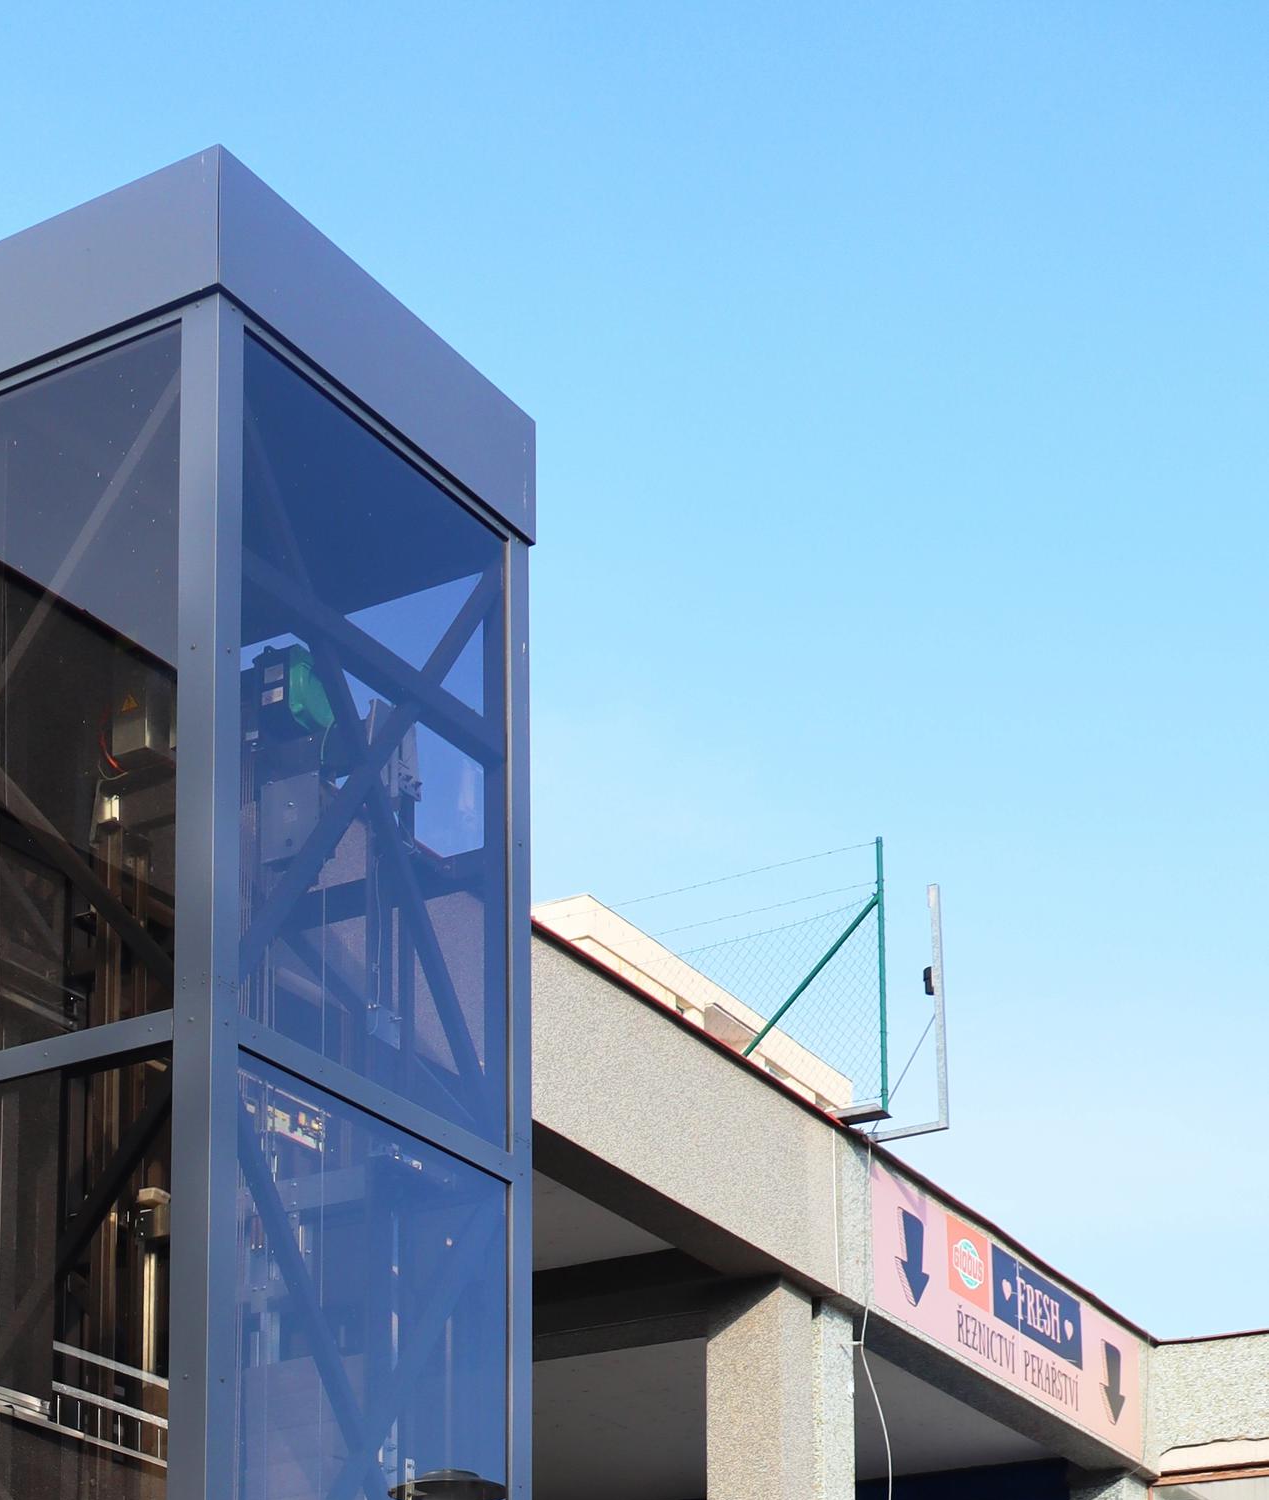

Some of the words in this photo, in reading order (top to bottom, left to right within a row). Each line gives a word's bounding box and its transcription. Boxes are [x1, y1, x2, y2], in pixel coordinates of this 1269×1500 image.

[1016, 1277, 1061, 1343] FRESH
[957, 1304, 1015, 1374] ŘEZNICTVÍ
[1023, 1350, 1079, 1411] PEKAŘSTVÍ
